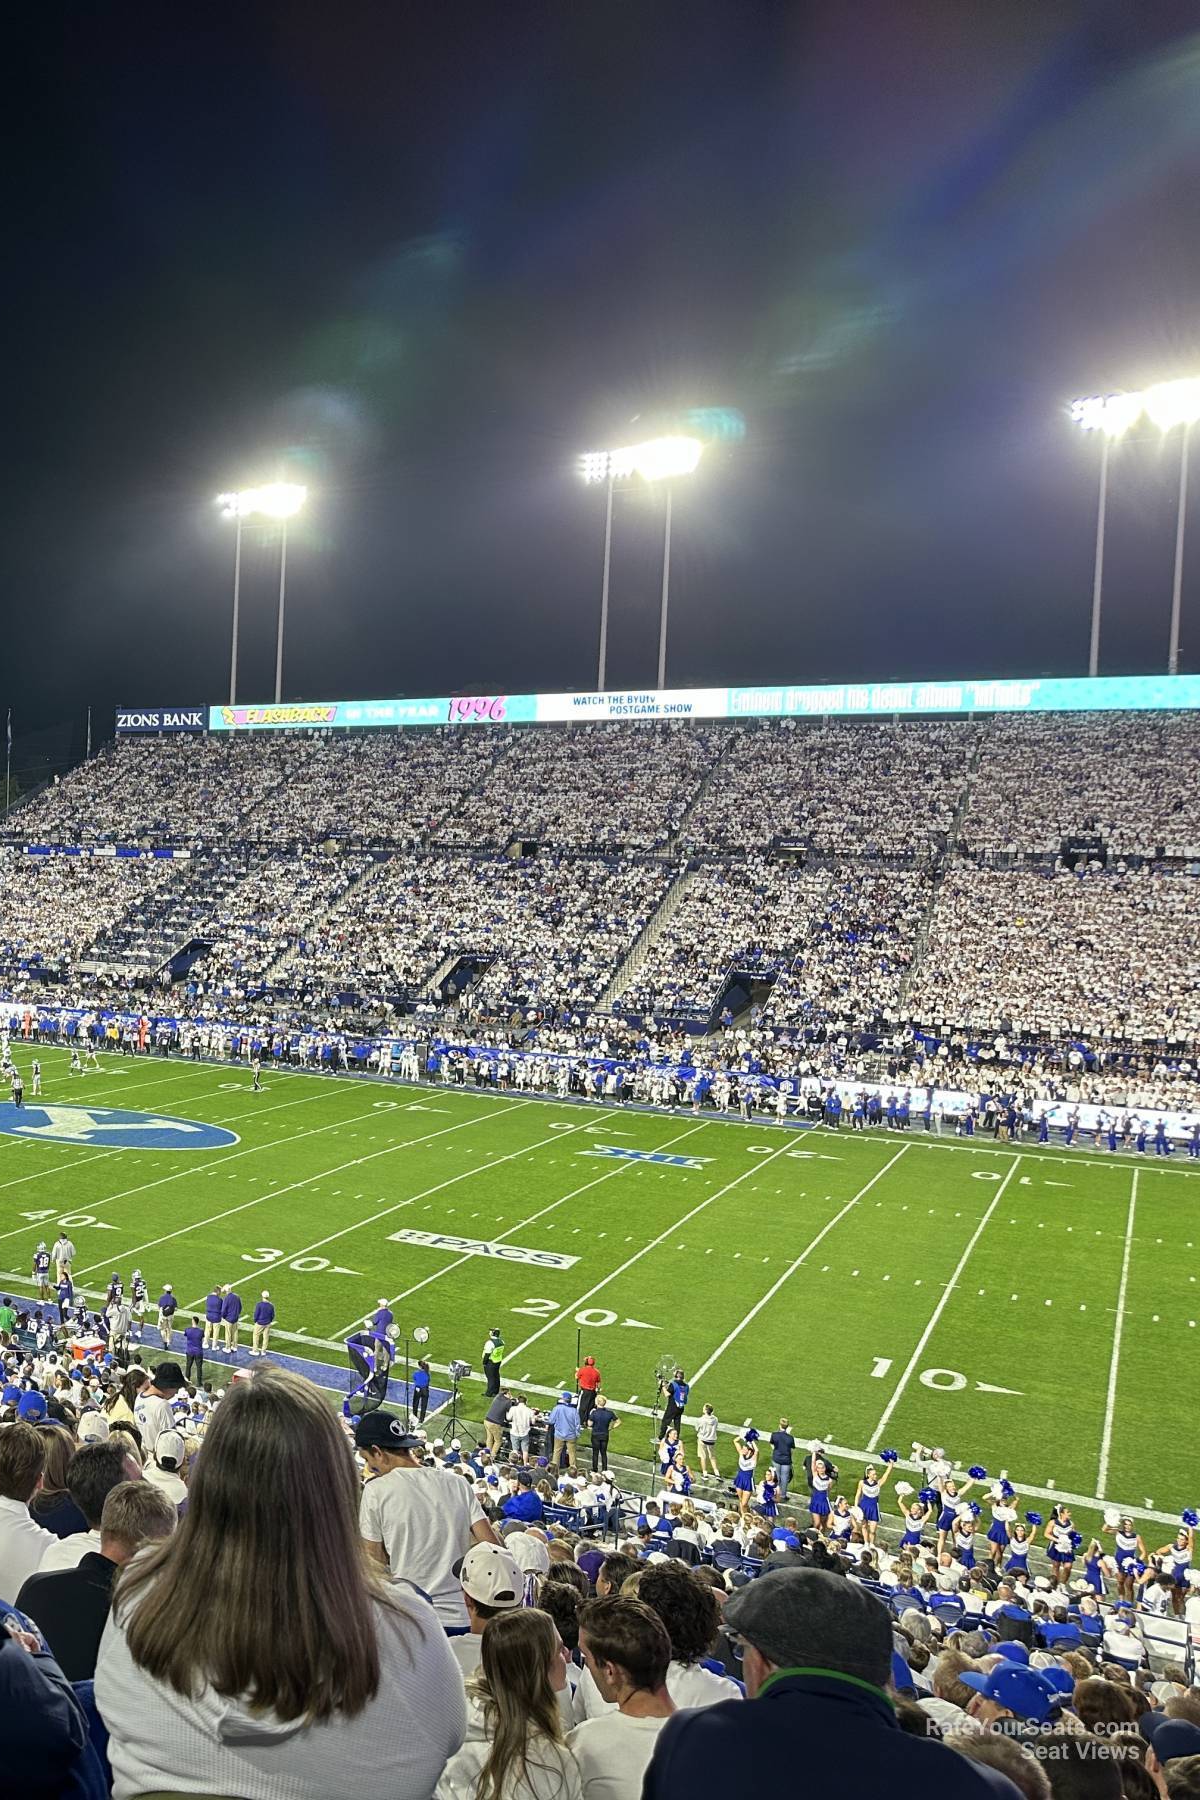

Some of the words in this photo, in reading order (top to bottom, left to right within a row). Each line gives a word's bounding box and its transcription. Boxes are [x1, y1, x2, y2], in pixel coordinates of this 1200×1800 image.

[246, 706, 330, 722] FLASHBACK
[447, 696, 506, 722] 1996
[573, 696, 605, 706] WATCH
[607, 696, 624, 704] THE
[627, 695, 656, 704] BYUtv
[610, 704, 661, 714] POSTGAME
[663, 703, 692, 713] SHOW
[117, 714, 160, 727] ZIONS
[163, 712, 203, 726] BANK
[18, 1209, 97, 1227] 40
[430, 1237, 566, 1265] PACS
[39, 1257, 49, 1268] 18
[241, 1248, 332, 1273] 30
[510, 1298, 619, 1328] 20
[27, 1320, 38, 1333] 19
[870, 1356, 968, 1391] 10
